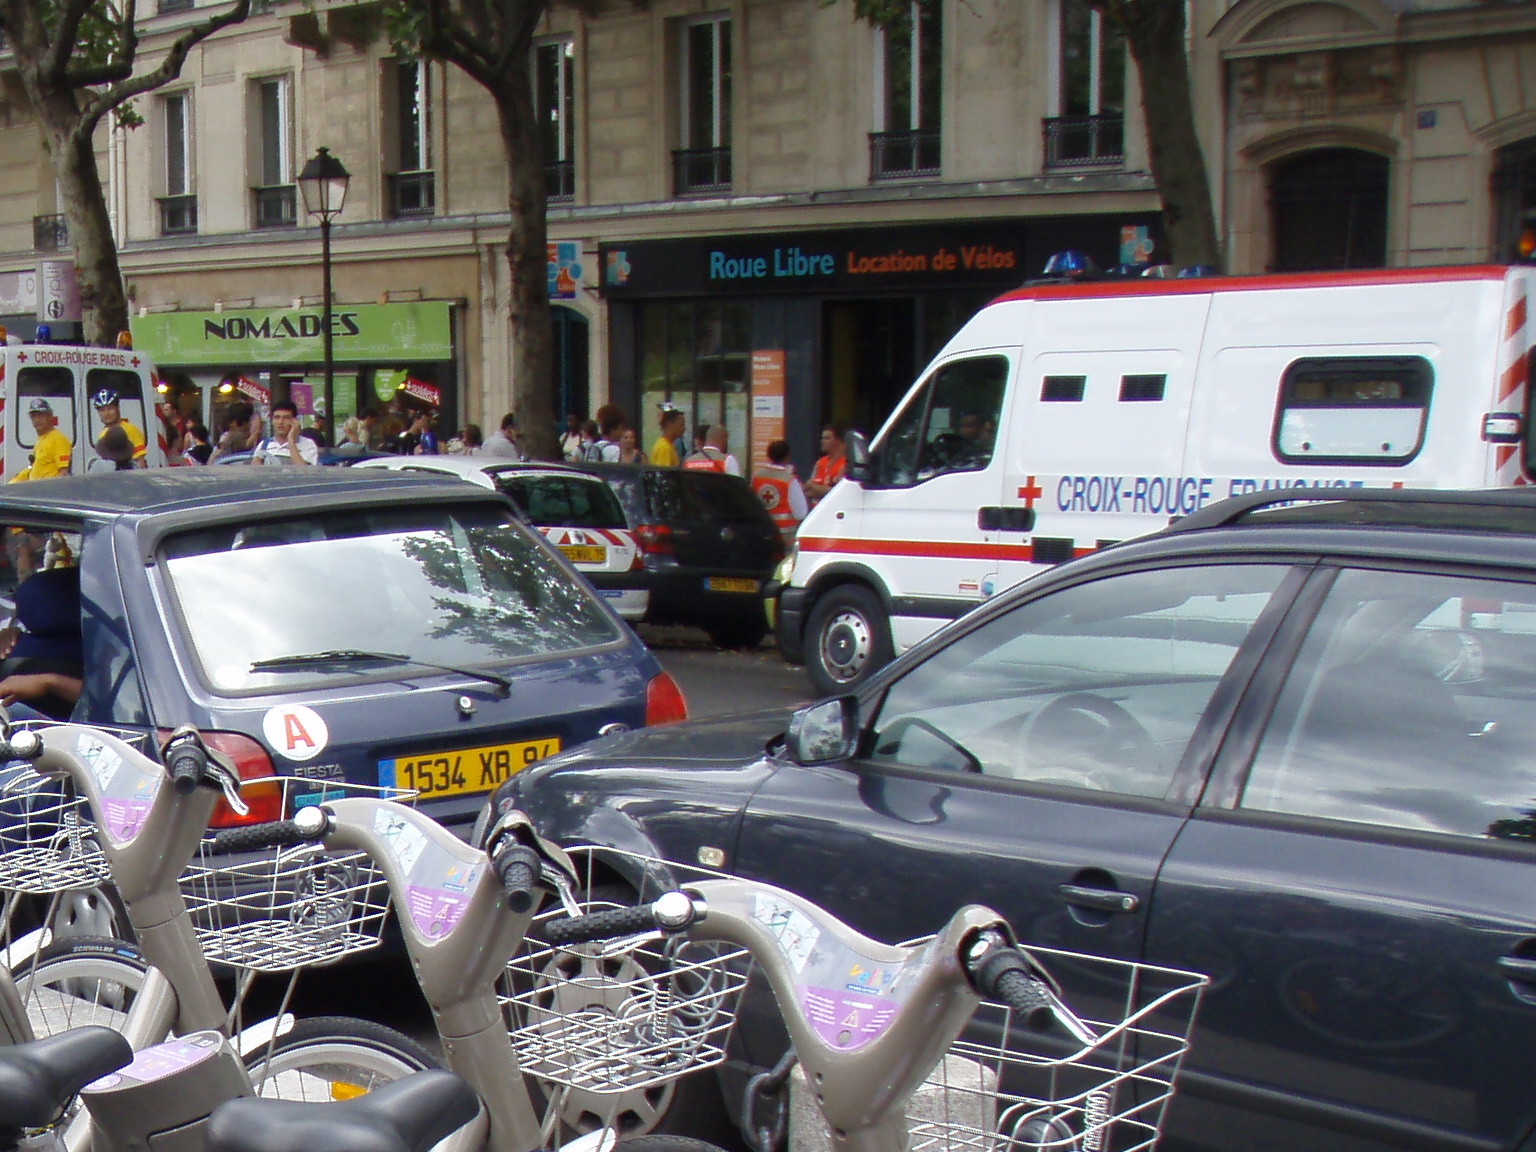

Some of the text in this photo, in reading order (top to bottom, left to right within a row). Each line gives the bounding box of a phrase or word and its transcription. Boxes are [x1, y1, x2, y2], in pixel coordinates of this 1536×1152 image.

[710, 247, 834, 279] Roue Libre
[848, 250, 927, 274] Location
[932, 248, 955, 271] de
[204, 312, 359, 341] NOMADES
[100, 353, 126, 367] PARIS
[1056, 475, 1212, 515] CROIX-ROUGE
[284, 713, 316, 751] A
[294, 764, 344, 779] FIESTA
[403, 756, 466, 797] 1534
